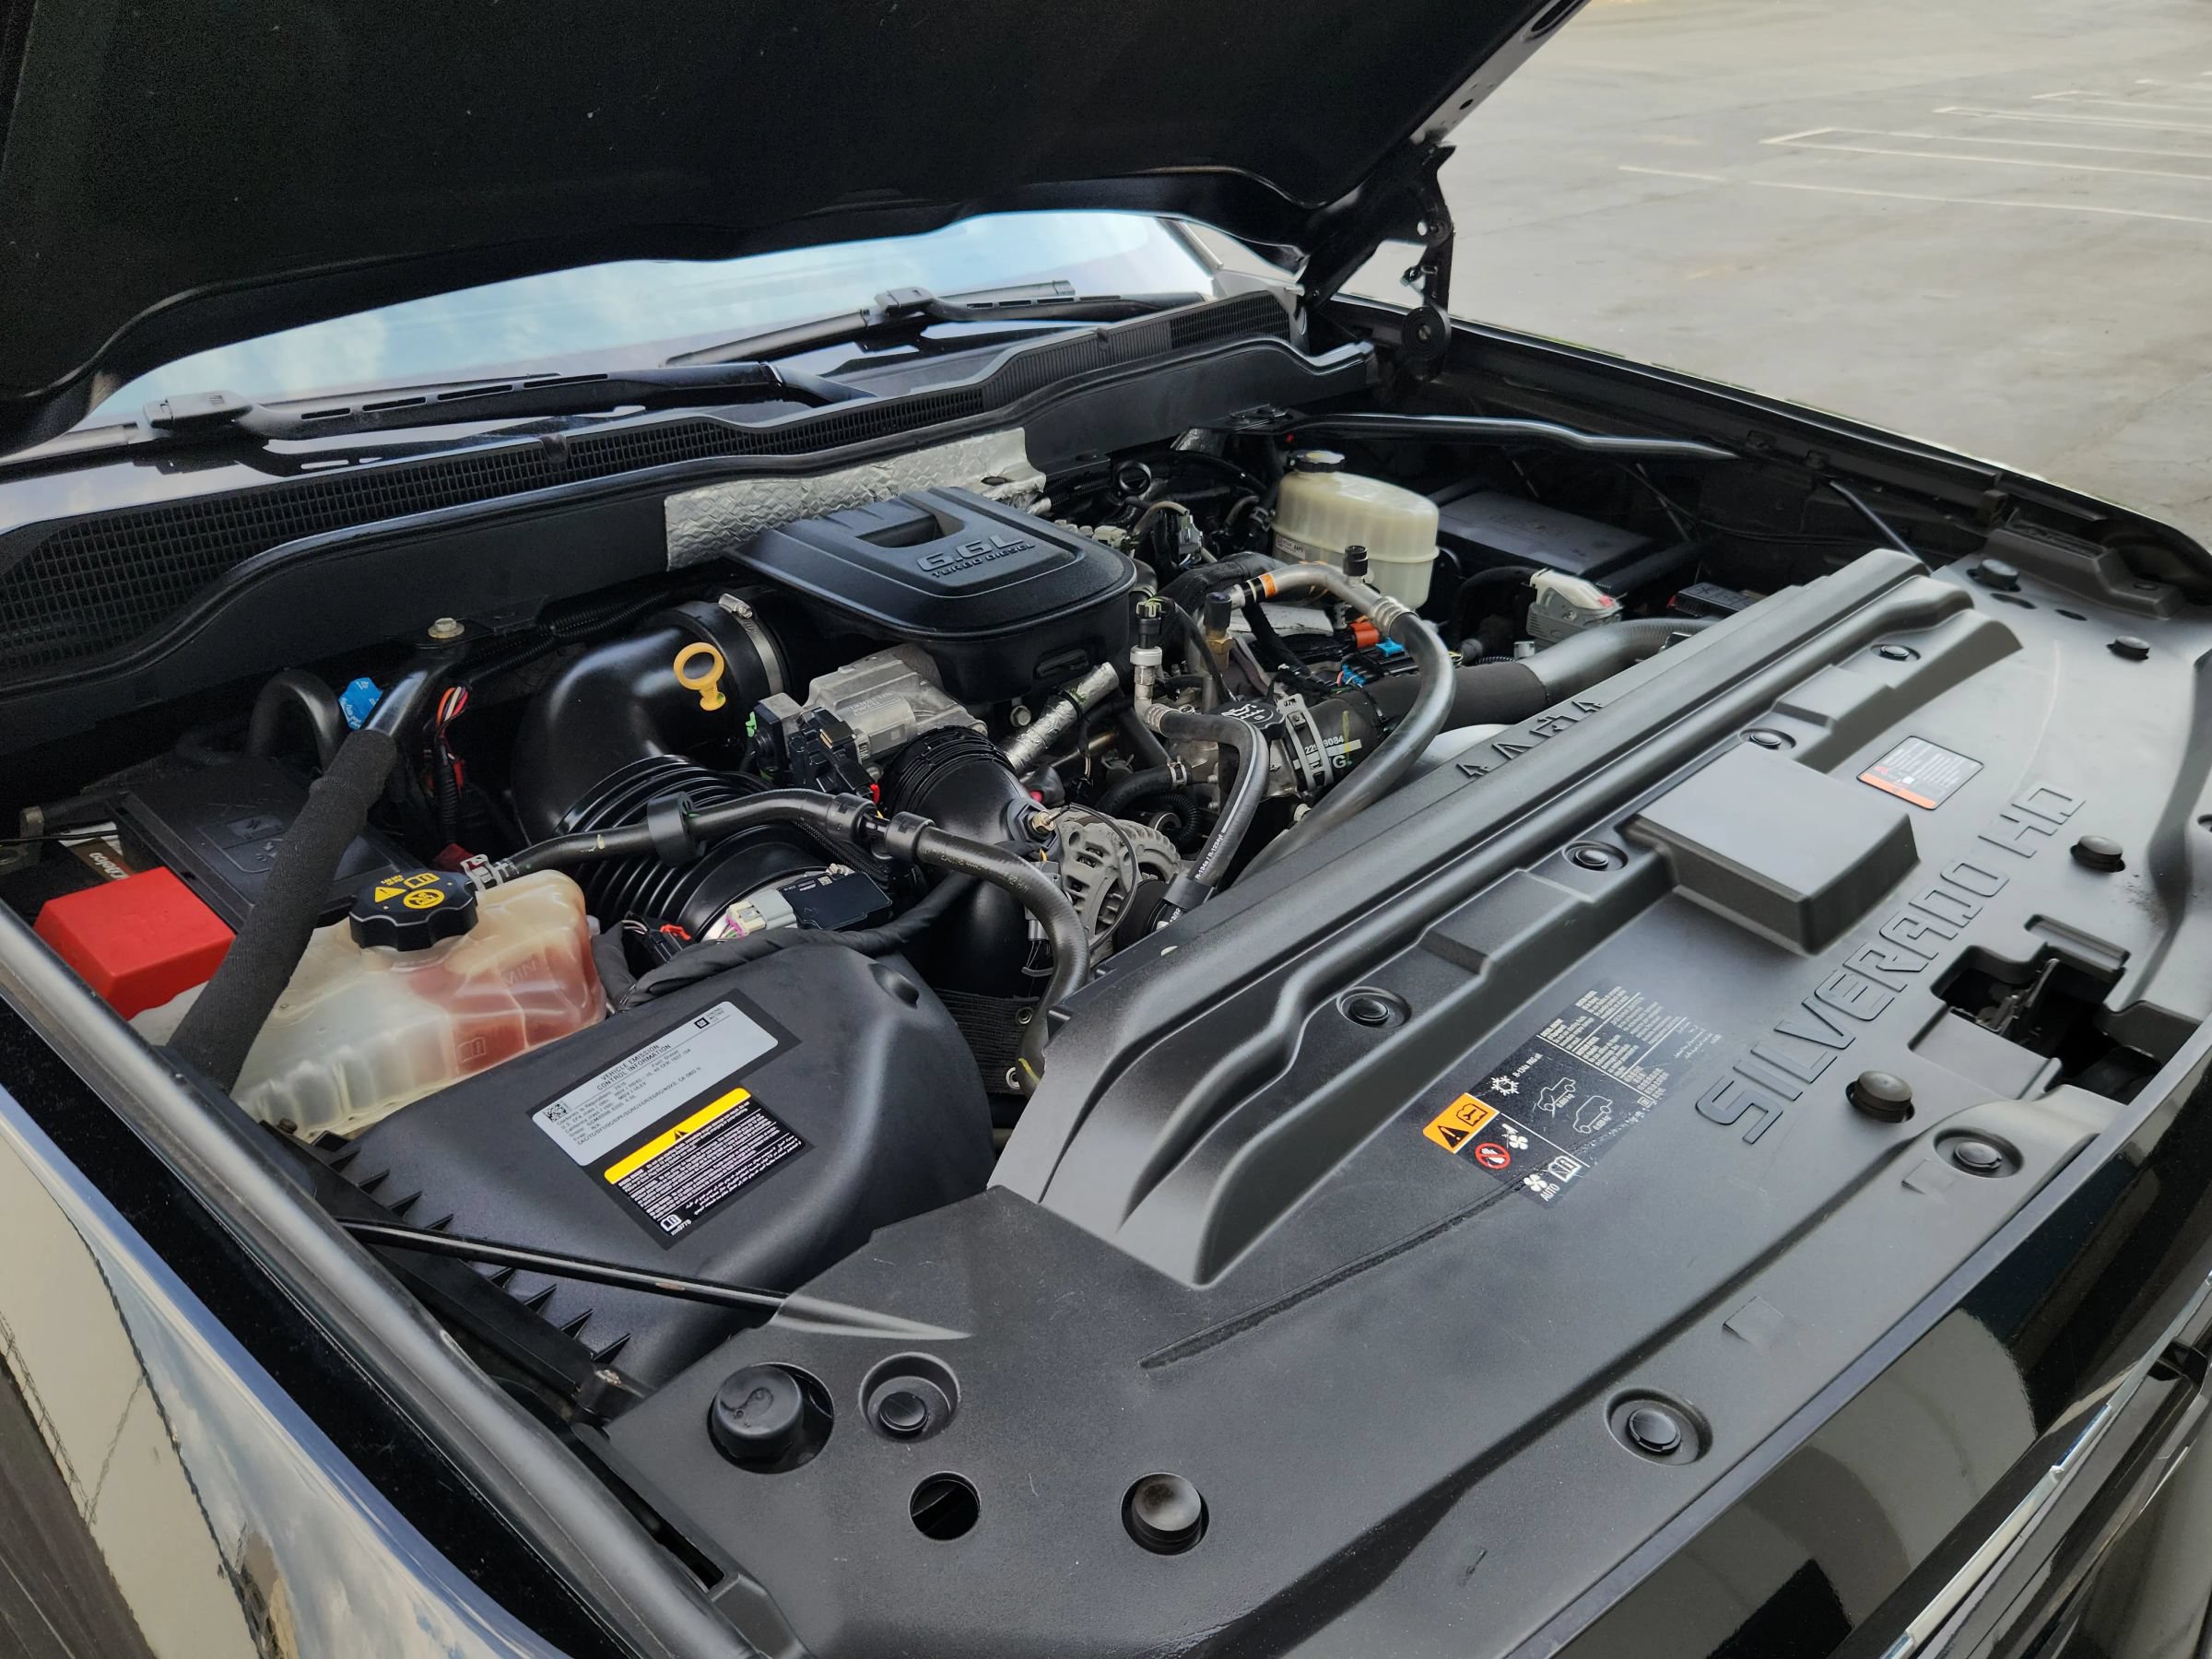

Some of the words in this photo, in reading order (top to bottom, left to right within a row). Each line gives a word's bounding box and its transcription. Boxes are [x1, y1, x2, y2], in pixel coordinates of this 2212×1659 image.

[917, 535, 1023, 571] 6.6L
[932, 558, 983, 578] TURBO
[985, 544, 1036, 561] DIESEL
[500, 959, 537, 988] MIN
[1696, 862, 2010, 1145] SILVERADO
[1978, 781, 2087, 859] HD
[595, 1069, 629, 1090] CONTROL
[626, 1043, 672, 1072] INFORMATION
[600, 1062, 629, 1081] VEHICLE
[627, 1043, 660, 1065] EMISSION
[1540, 1182, 1561, 1202] AUTO
